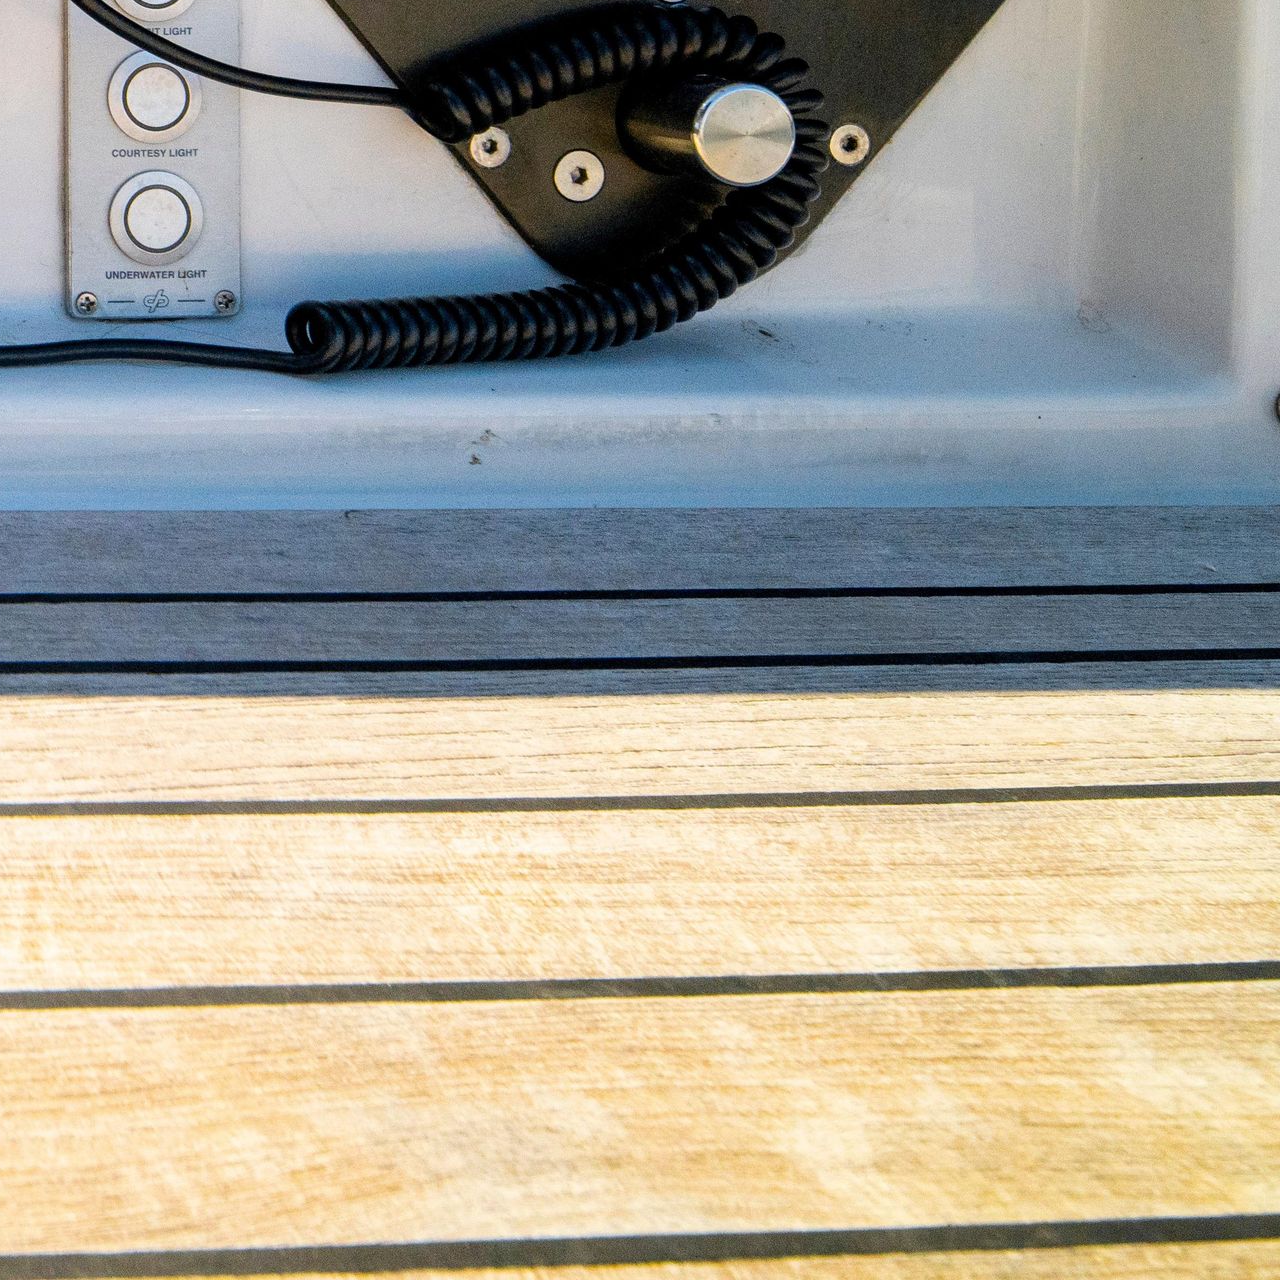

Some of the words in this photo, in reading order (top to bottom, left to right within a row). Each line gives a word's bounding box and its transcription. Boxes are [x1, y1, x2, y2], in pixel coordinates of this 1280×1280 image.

[163, 27, 192, 36] LIGHT
[112, 149, 166, 158] COURTESY
[169, 148, 198, 157] LIGHT
[105, 270, 175, 279] UNDERWATER
[178, 270, 207, 279] LIGHT
